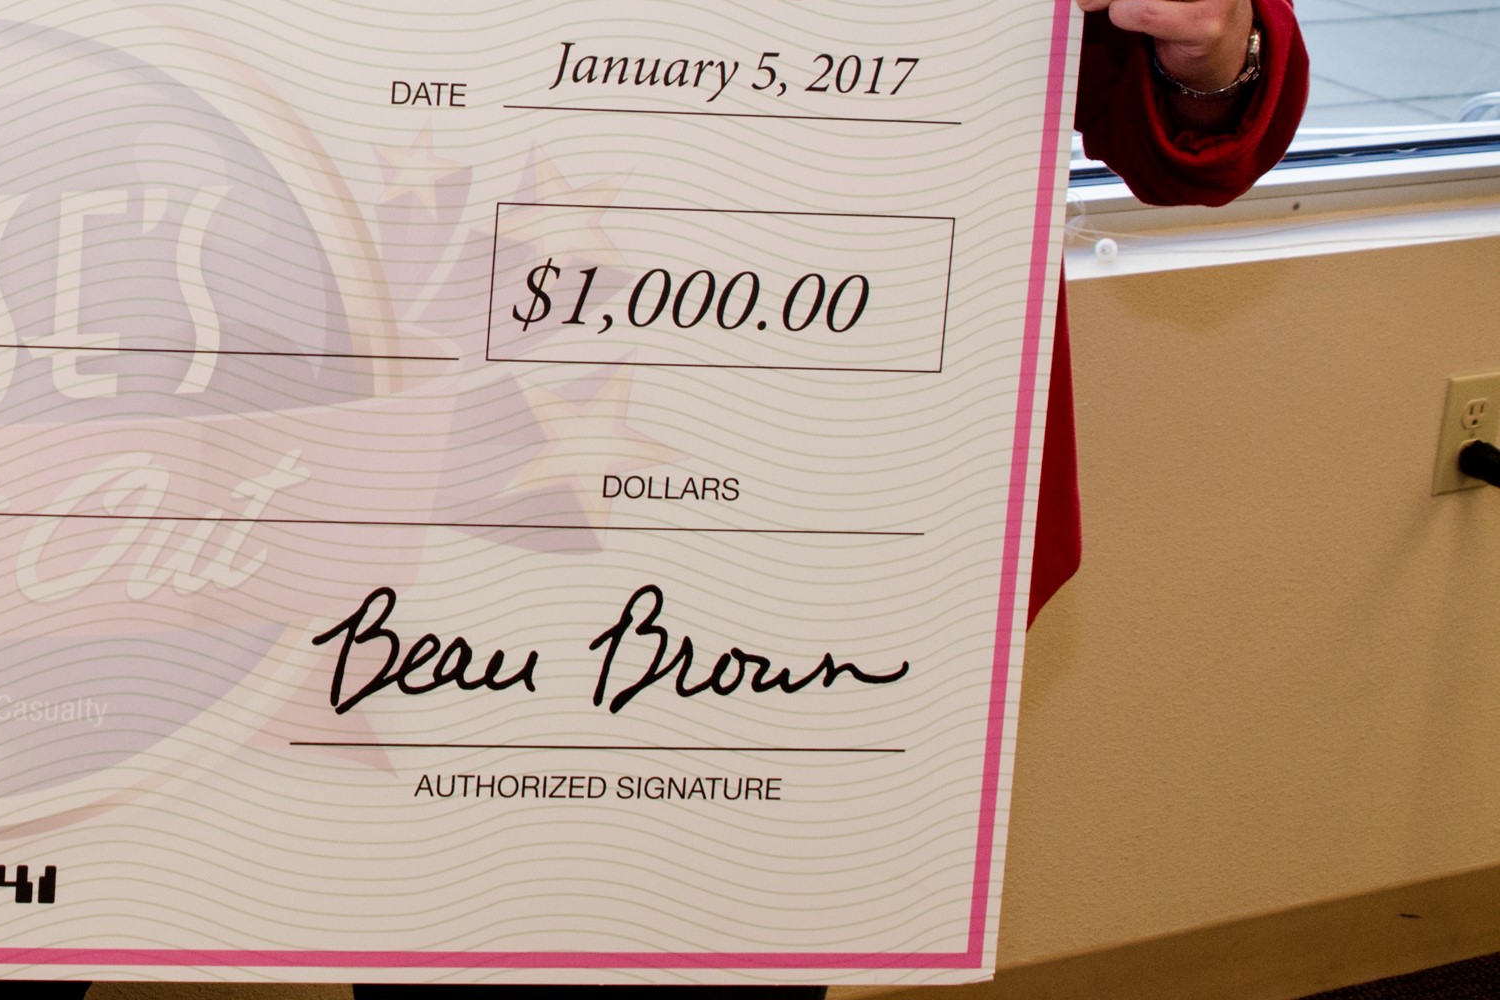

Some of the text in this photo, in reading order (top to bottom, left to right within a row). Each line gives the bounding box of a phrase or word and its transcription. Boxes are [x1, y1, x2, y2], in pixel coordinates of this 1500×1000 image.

[390, 80, 468, 108] DATE
[548, 41, 921, 103] January 5, 2017
[511, 257, 870, 335] $1,000.00
[601, 474, 740, 502] DOLLARS
[16, 447, 311, 606] Out
[311, 583, 910, 716] Beau Brown
[413, 774, 783, 801] AUTHORIZED SIGNATURE
